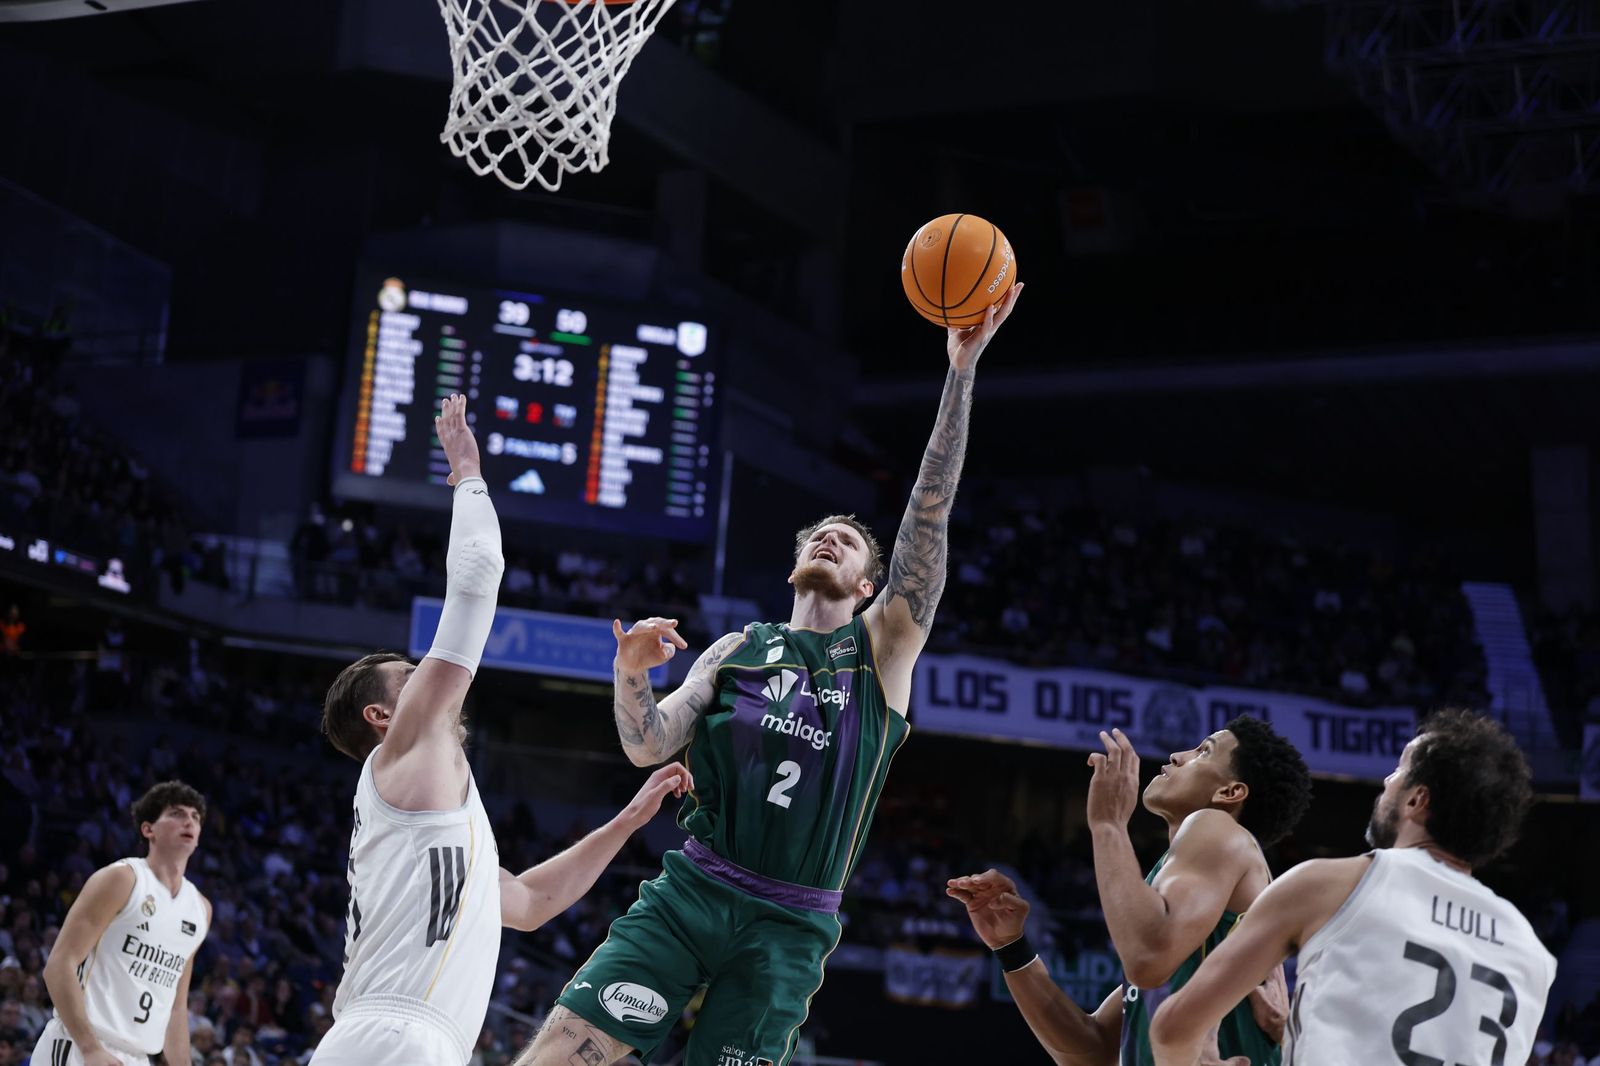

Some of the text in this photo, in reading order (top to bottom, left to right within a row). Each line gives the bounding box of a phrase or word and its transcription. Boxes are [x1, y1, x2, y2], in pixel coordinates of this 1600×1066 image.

[513, 353, 574, 387] 3:12
[927, 666, 1009, 713] LOS
[1035, 678, 1134, 730] OJOS
[1305, 710, 1415, 758] TIGRE
[766, 760, 801, 809] 2
[1431, 895, 1504, 947] LLULL
[122, 934, 185, 972] Emirate
[128, 960, 177, 989] FLY BETTER
[133, 991, 153, 1023] 9
[1391, 940, 1518, 1066] 23
[721, 1043, 747, 1058] sabor
